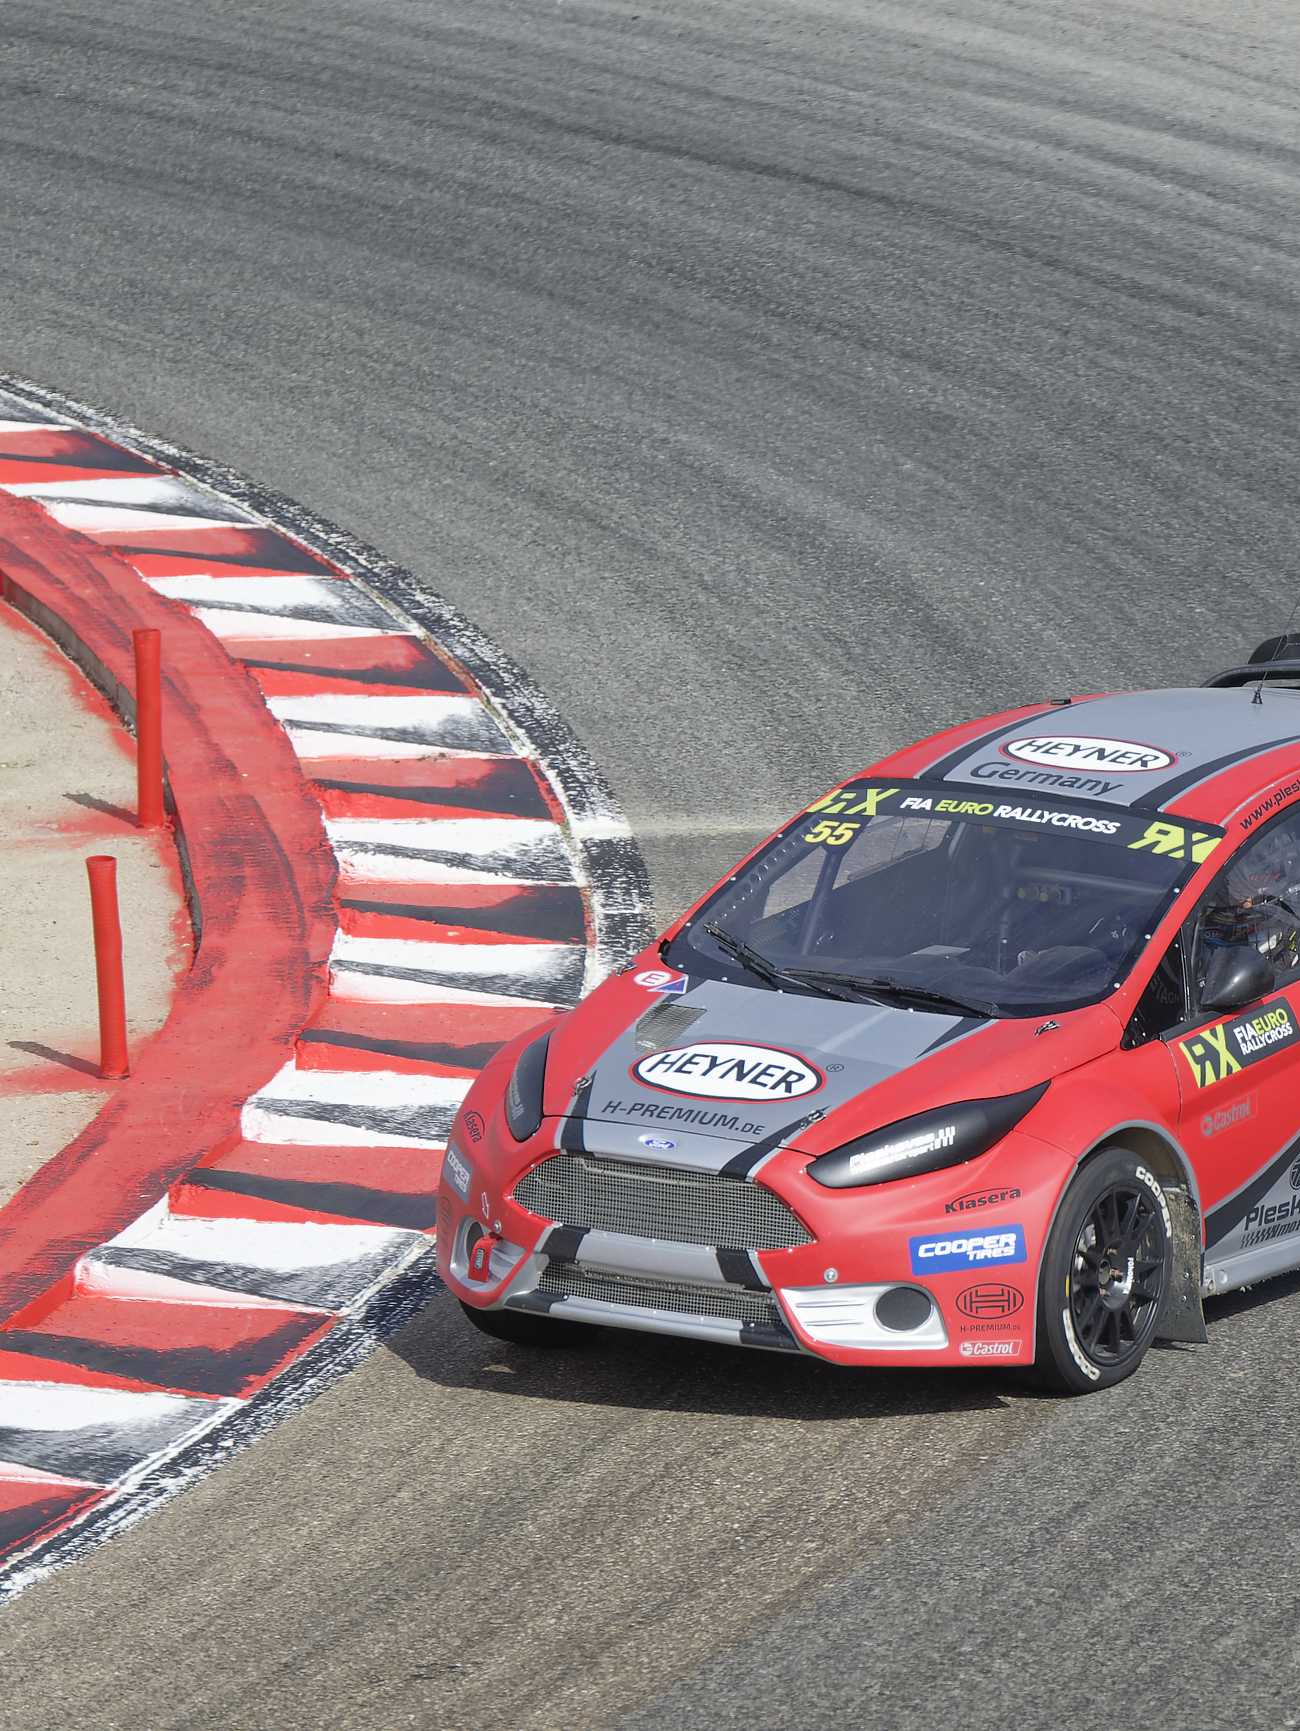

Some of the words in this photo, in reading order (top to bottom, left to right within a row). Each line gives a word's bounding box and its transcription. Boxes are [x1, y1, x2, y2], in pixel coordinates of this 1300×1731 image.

[1015, 739, 1160, 768] HEYNER
[970, 761, 1125, 796] Germany
[900, 797, 932, 810] FIA
[935, 800, 993, 815] EURO
[993, 804, 1120, 834] RALLYCROSS
[804, 819, 861, 845] 55
[642, 973, 665, 985] E
[1240, 1022, 1293, 1055] RALLYCROSS
[646, 1052, 805, 1093] HEYNER
[602, 1100, 765, 1135] H-PREMIUM.DE
[945, 1187, 1021, 1213] Klasera
[918, 1233, 1016, 1257] COOPER
[967, 1247, 1015, 1261] TIRES
[974, 1342, 1013, 1355] Castrol
